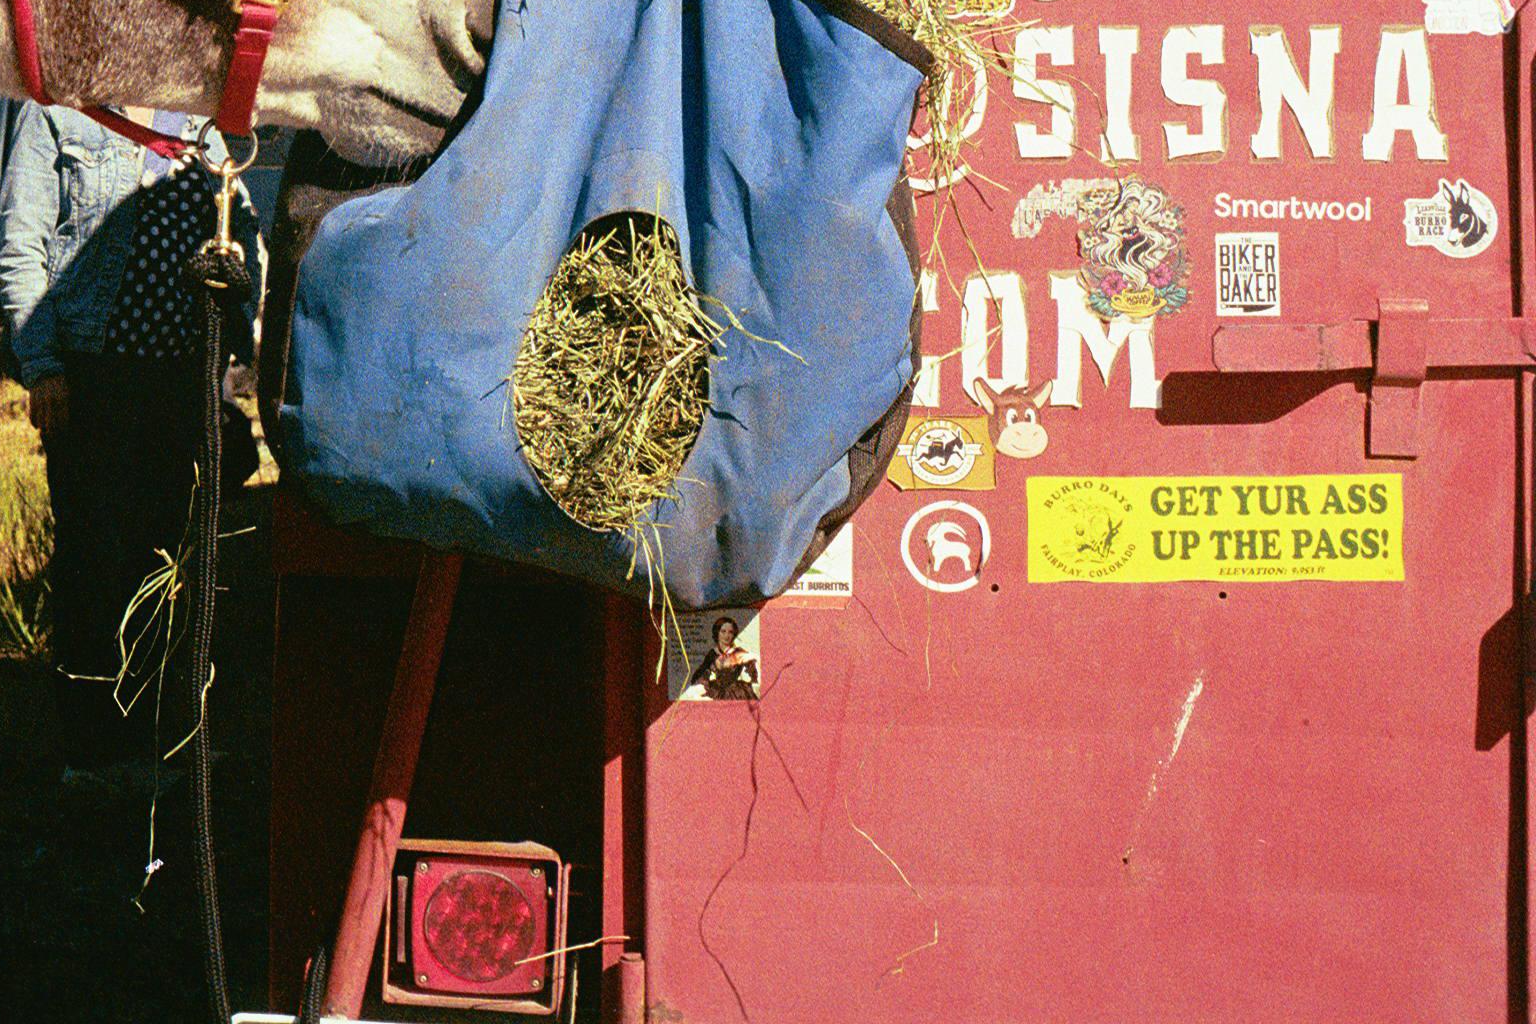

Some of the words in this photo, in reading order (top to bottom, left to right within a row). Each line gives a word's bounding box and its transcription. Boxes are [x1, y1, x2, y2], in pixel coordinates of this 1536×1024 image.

[1214, 192, 1372, 222] Smartwool
[1415, 216, 1446, 226] BURRO
[1419, 226, 1444, 236] RACE
[1220, 244, 1276, 273] BIKER
[1220, 267, 1277, 302] BAKER
[1043, 480, 1094, 509] BURRO
[1098, 483, 1133, 512] DAYS
[1150, 485, 1223, 516] GET
[1230, 484, 1311, 515] YUR
[1319, 483, 1389, 514] ASS
[1151, 529, 1201, 560] UP
[1209, 529, 1283, 560] THE
[1291, 527, 1390, 560] PASS!
[1088, 543, 1137, 578] COLORADO
[1218, 567, 1288, 576] ELEVATION:
[807, 581, 850, 592] BURRITOS
